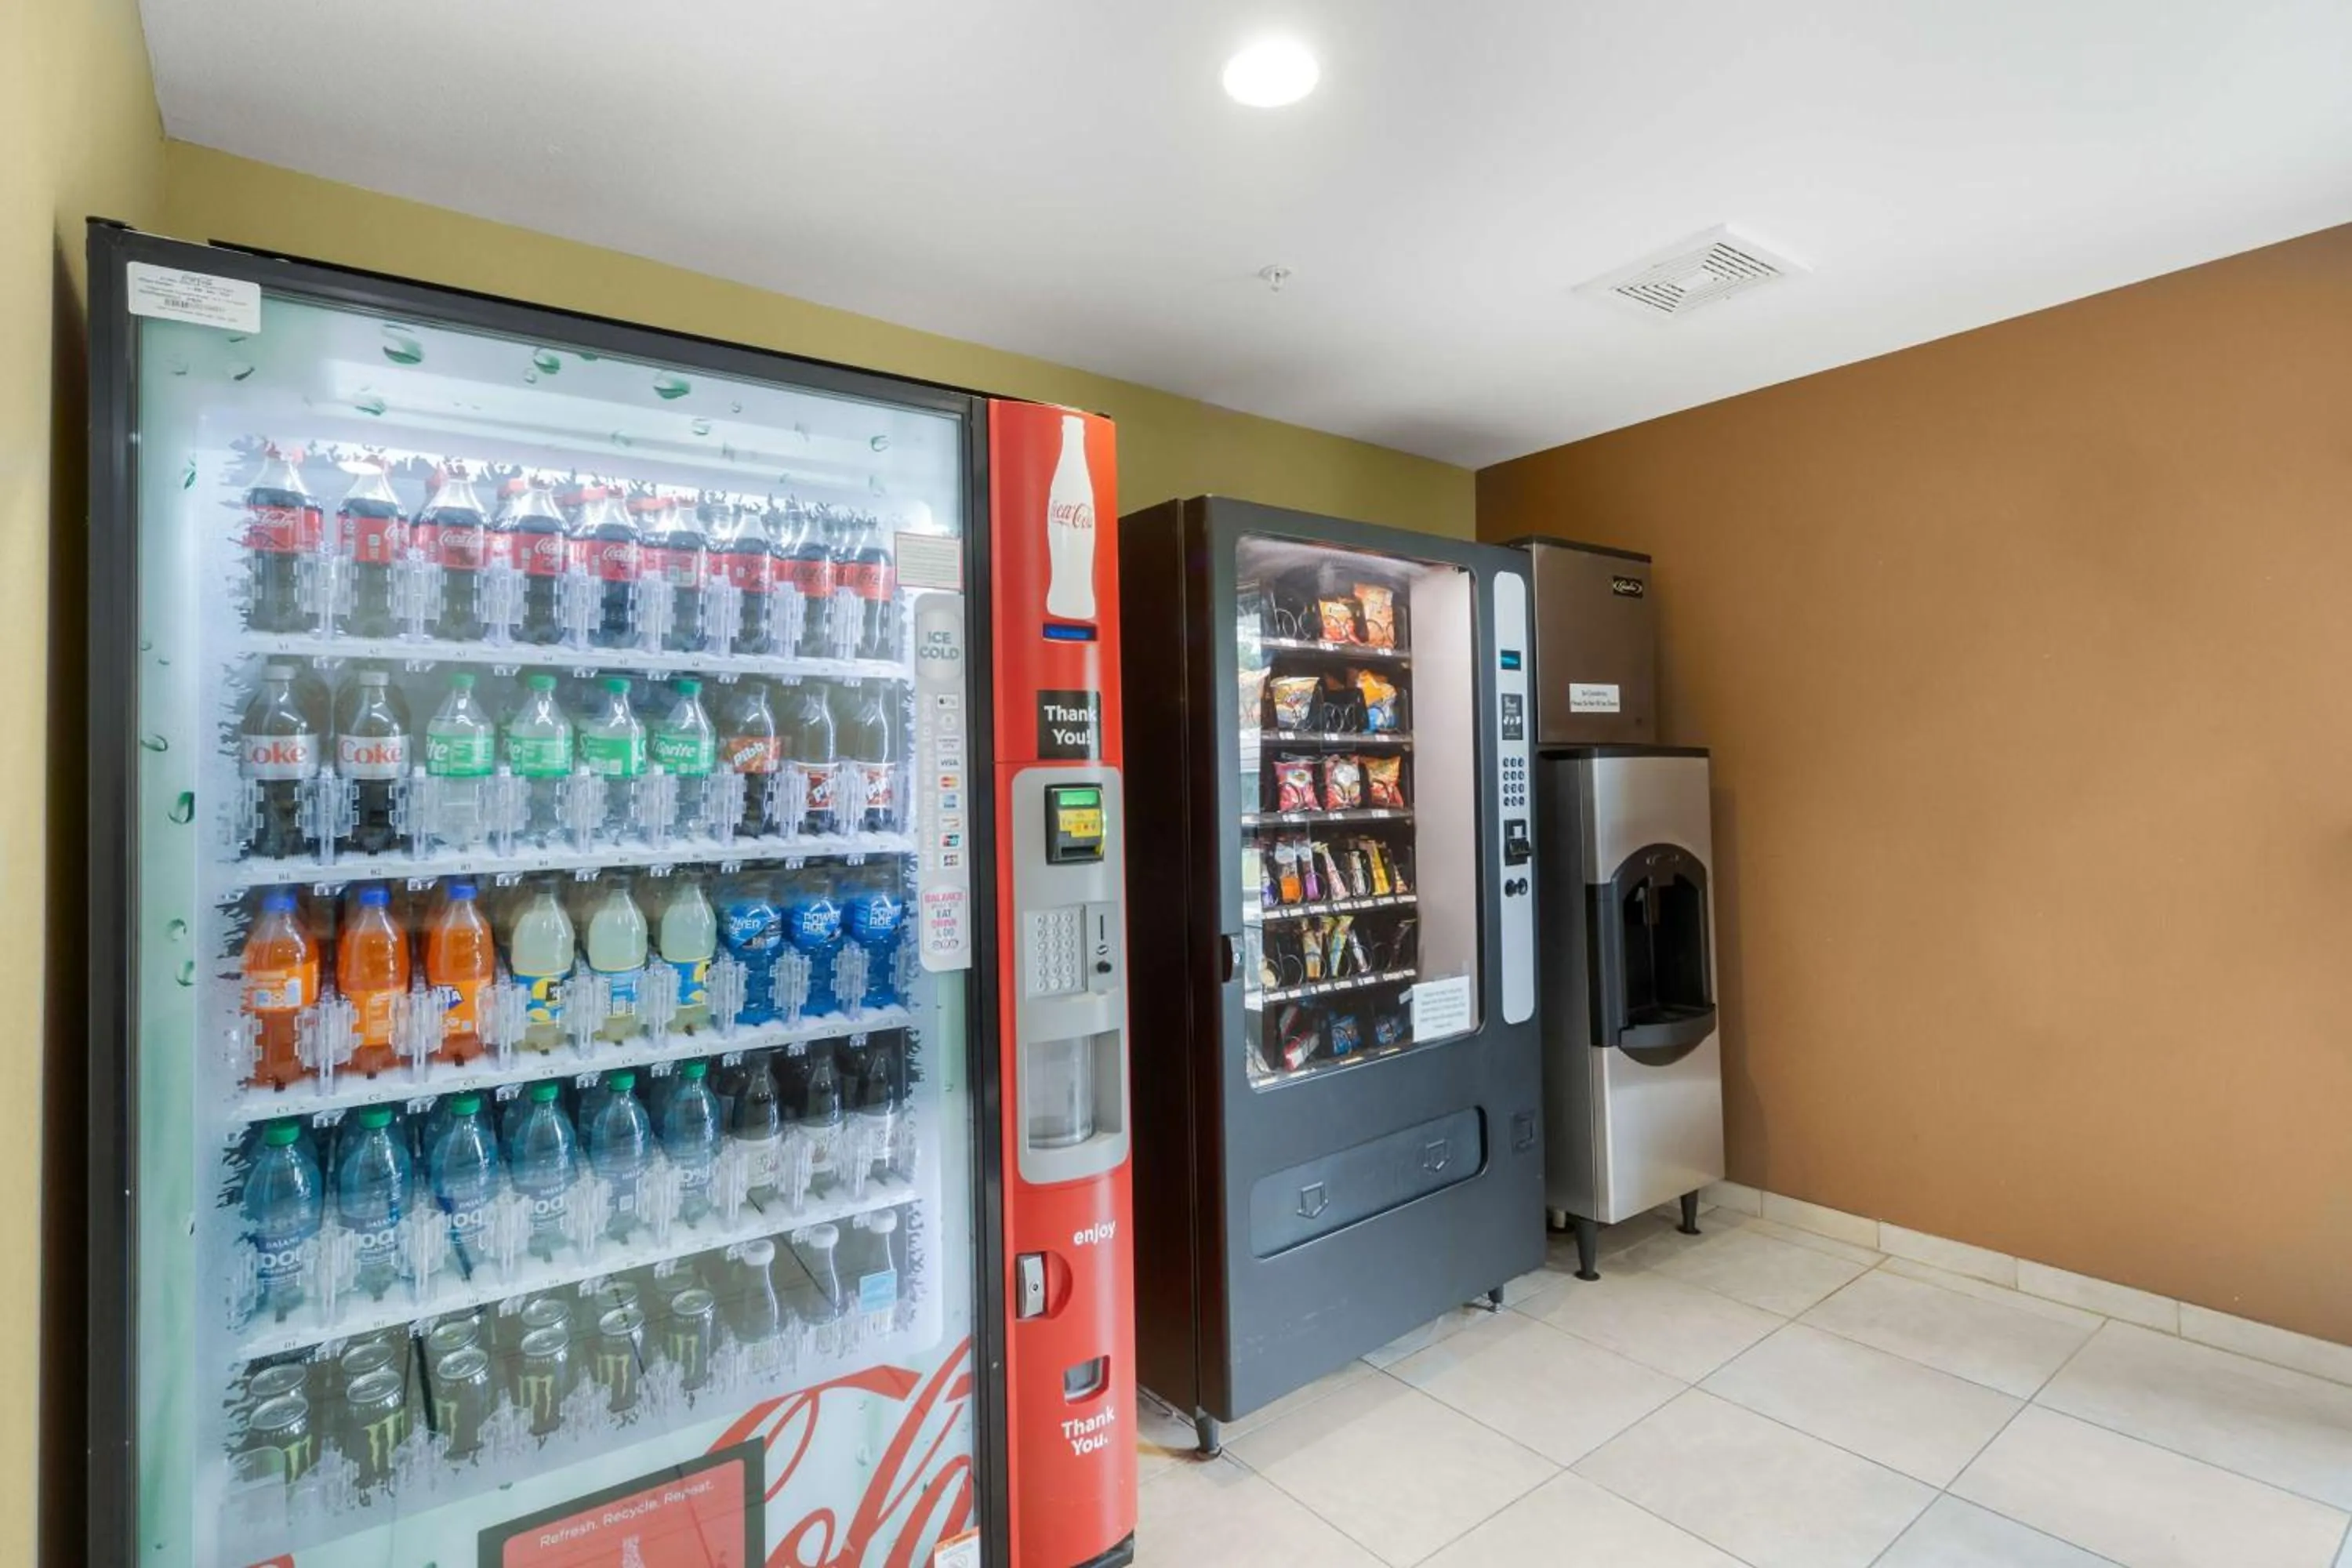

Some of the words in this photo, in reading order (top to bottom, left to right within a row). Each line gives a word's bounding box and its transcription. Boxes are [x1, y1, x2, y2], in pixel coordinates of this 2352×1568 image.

[927, 631, 953, 644] ICE
[918, 644, 960, 660] COLD
[1044, 704, 1097, 723] Thank
[1051, 728, 1091, 746] You!
[1073, 1220, 1116, 1247] enjoy
[1061, 1404, 1116, 1439] Thank
[1071, 1436, 1109, 1457] You.
[539, 1519, 599, 1550] Refresh.
[602, 1498, 660, 1526] Recycle.
